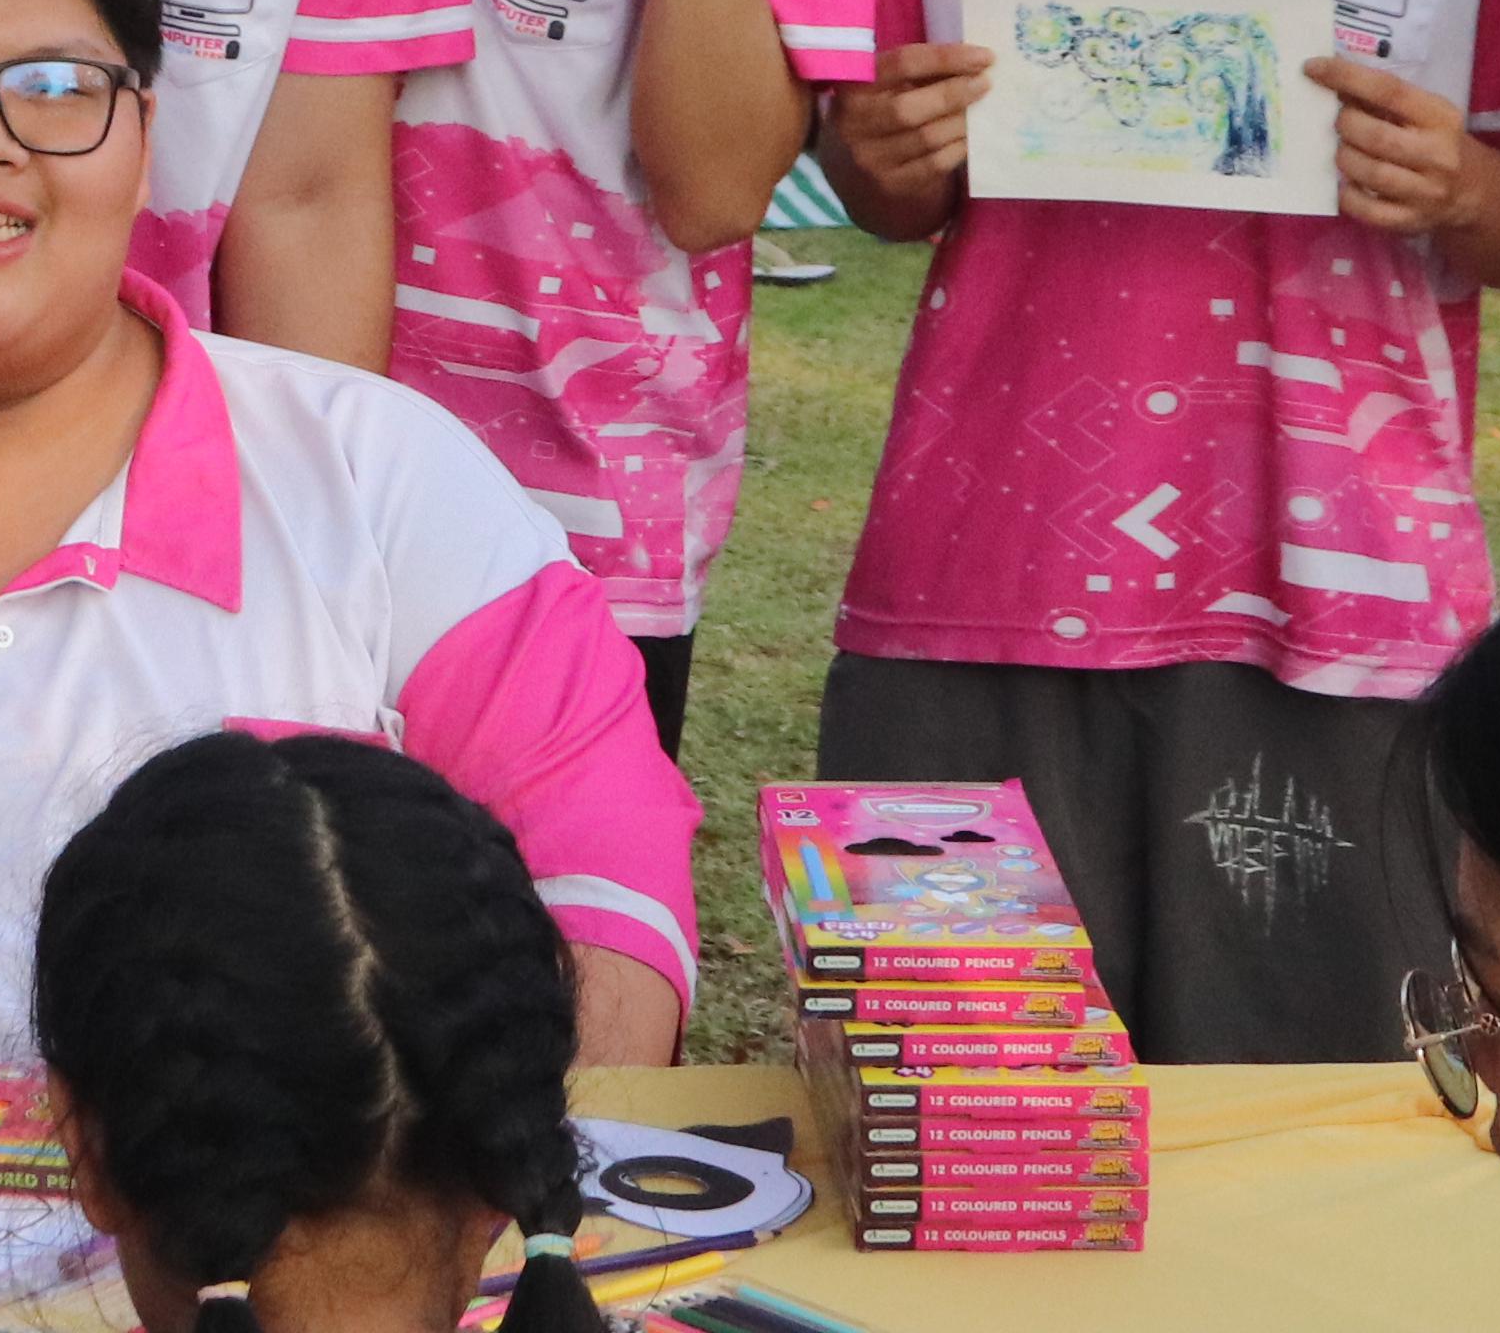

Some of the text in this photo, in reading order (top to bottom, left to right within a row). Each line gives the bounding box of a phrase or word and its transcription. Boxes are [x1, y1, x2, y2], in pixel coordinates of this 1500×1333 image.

[873, 957, 1015, 969] 12 COLOURED PENCILS
[865, 999, 1007, 1012] 12 COLOURED PENCILS
[912, 1043, 1053, 1055] 12 COLOURED PENCILS
[930, 1095, 945, 1106] 12
[949, 1095, 1017, 1107] COLOURED
[1022, 1096, 1073, 1108] PENCILS
[929, 1129, 944, 1141] 12
[948, 1129, 1017, 1141] COLOURED
[1021, 1129, 1072, 1141] PENCILS
[931, 1163, 1073, 1175] 12 COLOURED PENCILS
[931, 1200, 1073, 1212] 12 COLOURED PENCILS
[924, 1230, 939, 1241] 12
[943, 1230, 1012, 1242] COLOURED
[1016, 1229, 1067, 1242] PENCILS
